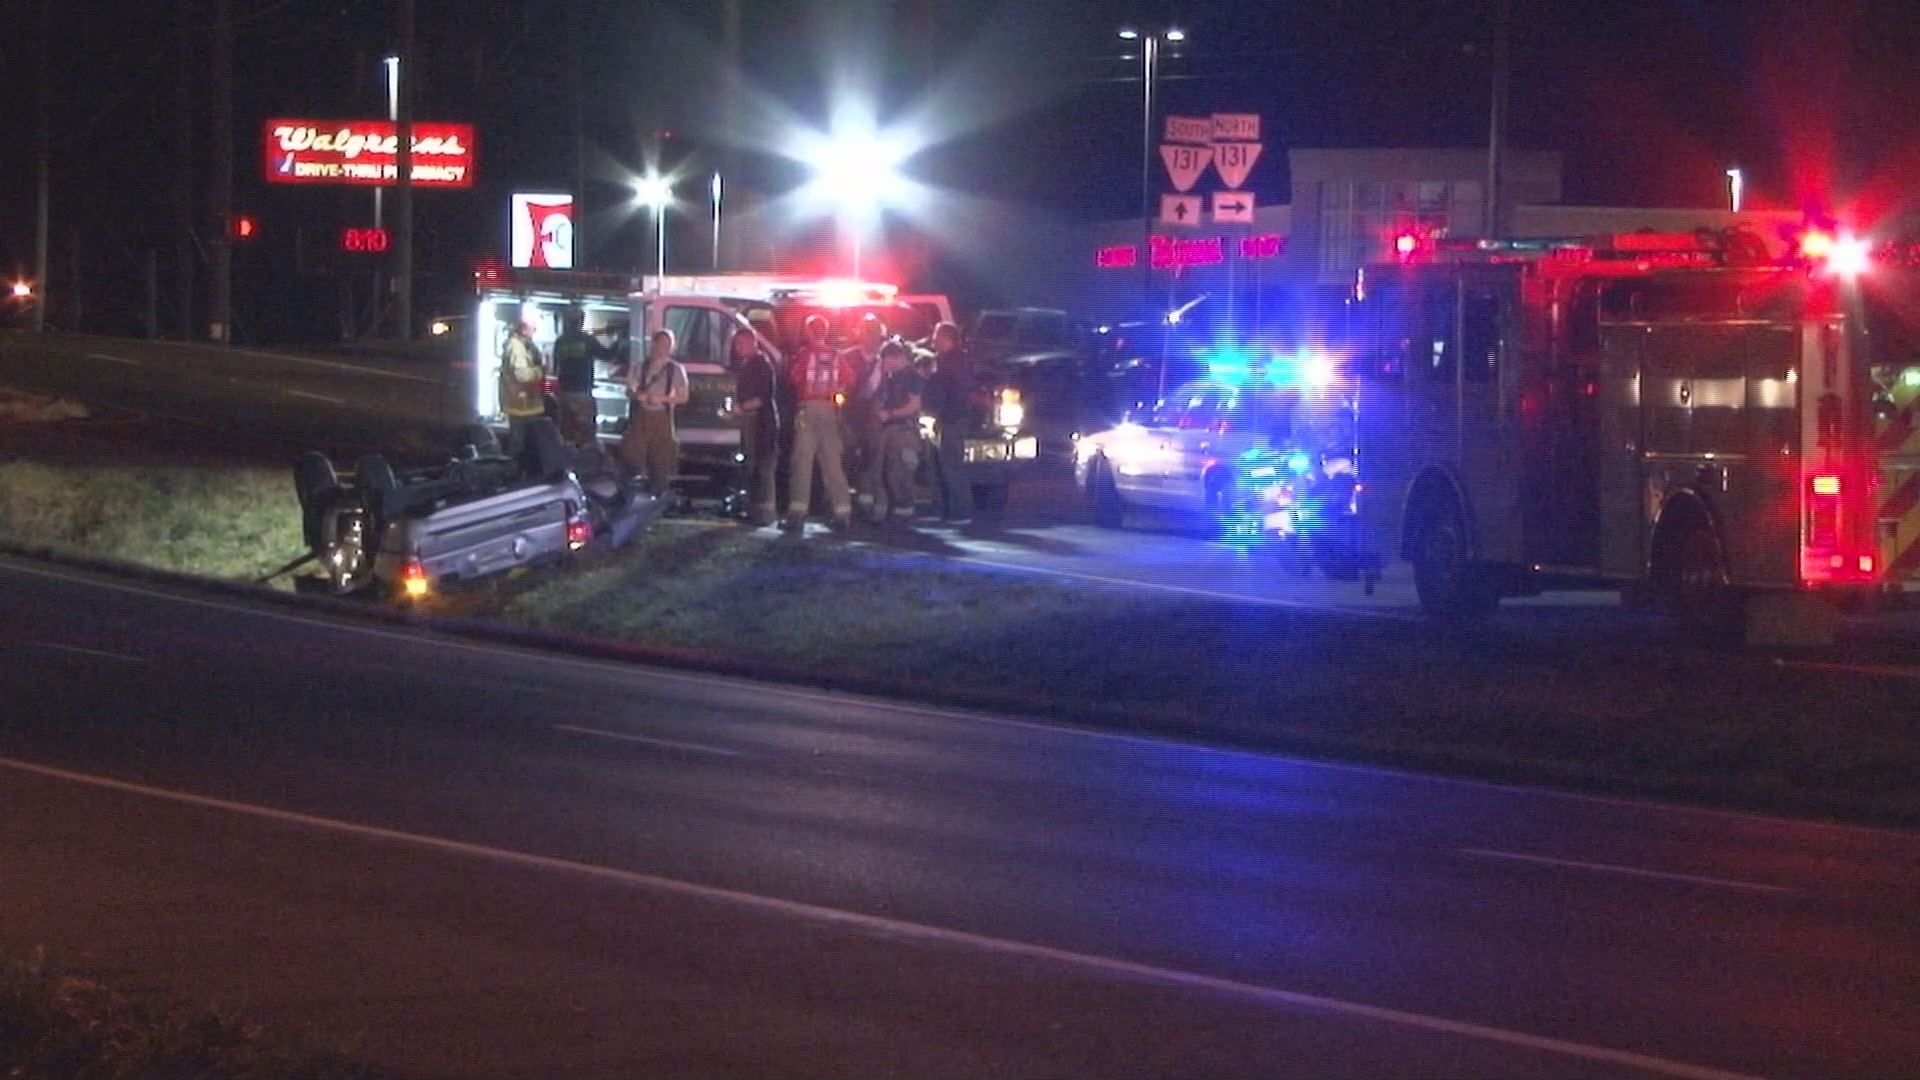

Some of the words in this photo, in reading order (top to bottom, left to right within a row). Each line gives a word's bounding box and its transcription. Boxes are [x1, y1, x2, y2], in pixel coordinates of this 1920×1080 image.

[1215, 118, 1257, 134] NORTH
[274, 126, 466, 158] Walgrens
[1173, 149, 1198, 170] 131
[1222, 146, 1247, 167] 131
[384, 163, 465, 181] PRMACY
